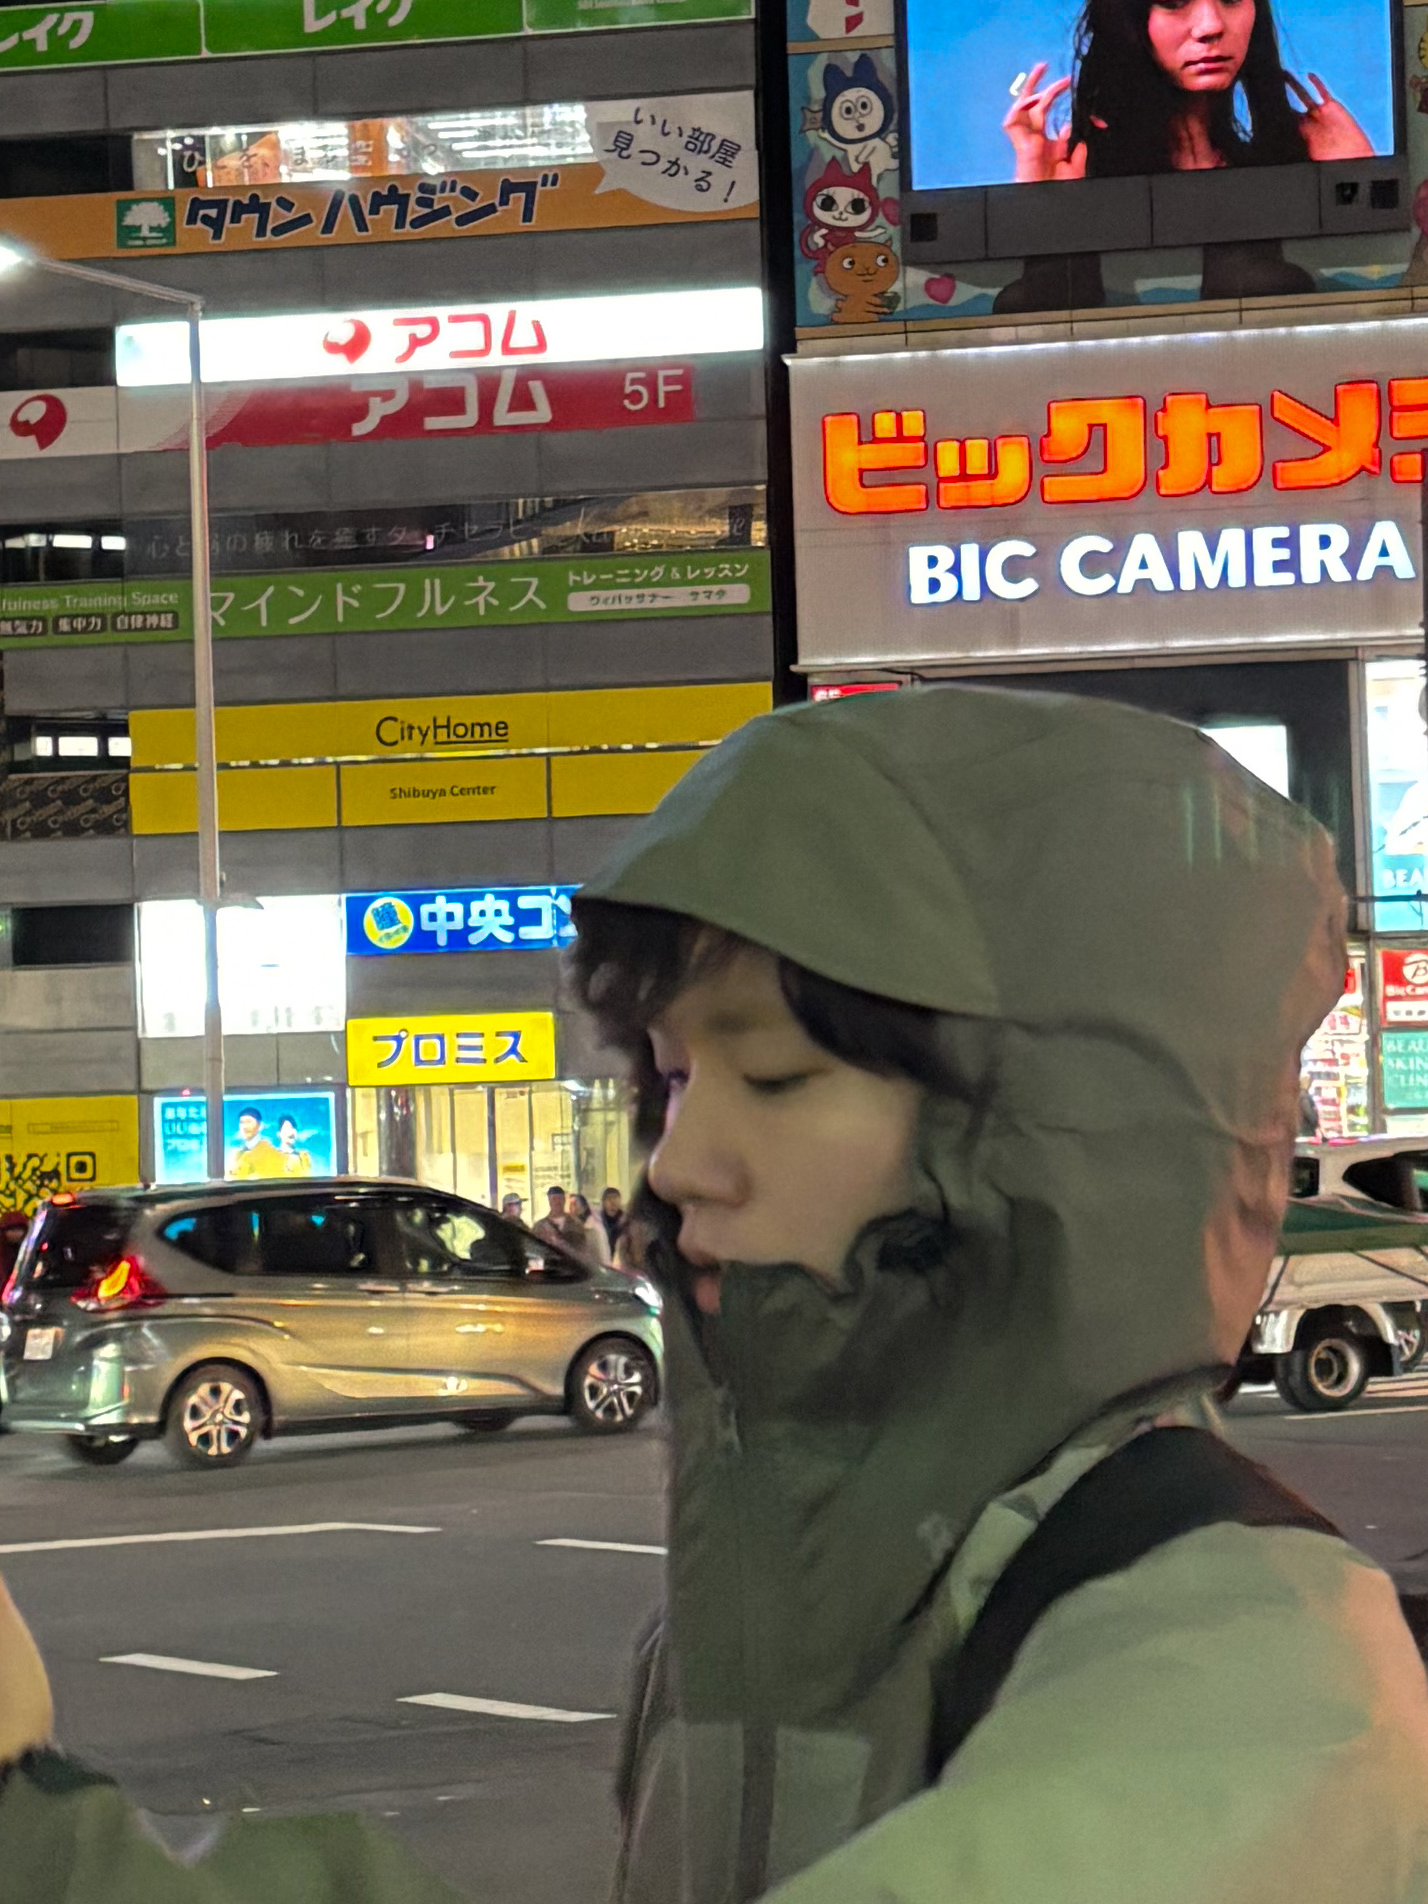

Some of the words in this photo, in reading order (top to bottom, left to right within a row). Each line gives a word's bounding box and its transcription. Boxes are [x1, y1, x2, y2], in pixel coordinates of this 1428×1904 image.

[633, 106, 742, 169] いい部屋
[603, 129, 738, 204] 見つかる！
[185, 172, 560, 242] タウンハウジング
[392, 309, 548, 364] アコム
[350, 369, 553, 437] アコム
[622, 369, 685, 411] 5F
[568, 564, 667, 587] トレーニング
[687, 563, 749, 580] レッスン
[907, 539, 1041, 606] BIC
[1059, 519, 1417, 597] CAMERA
[63, 594, 128, 610] Training
[130, 592, 179, 607] Space
[209, 575, 548, 628] マインドフルネス
[389, 784, 447, 802] Shibuya
[449, 783, 498, 798] Center
[372, 1027, 529, 1069] プロミス
